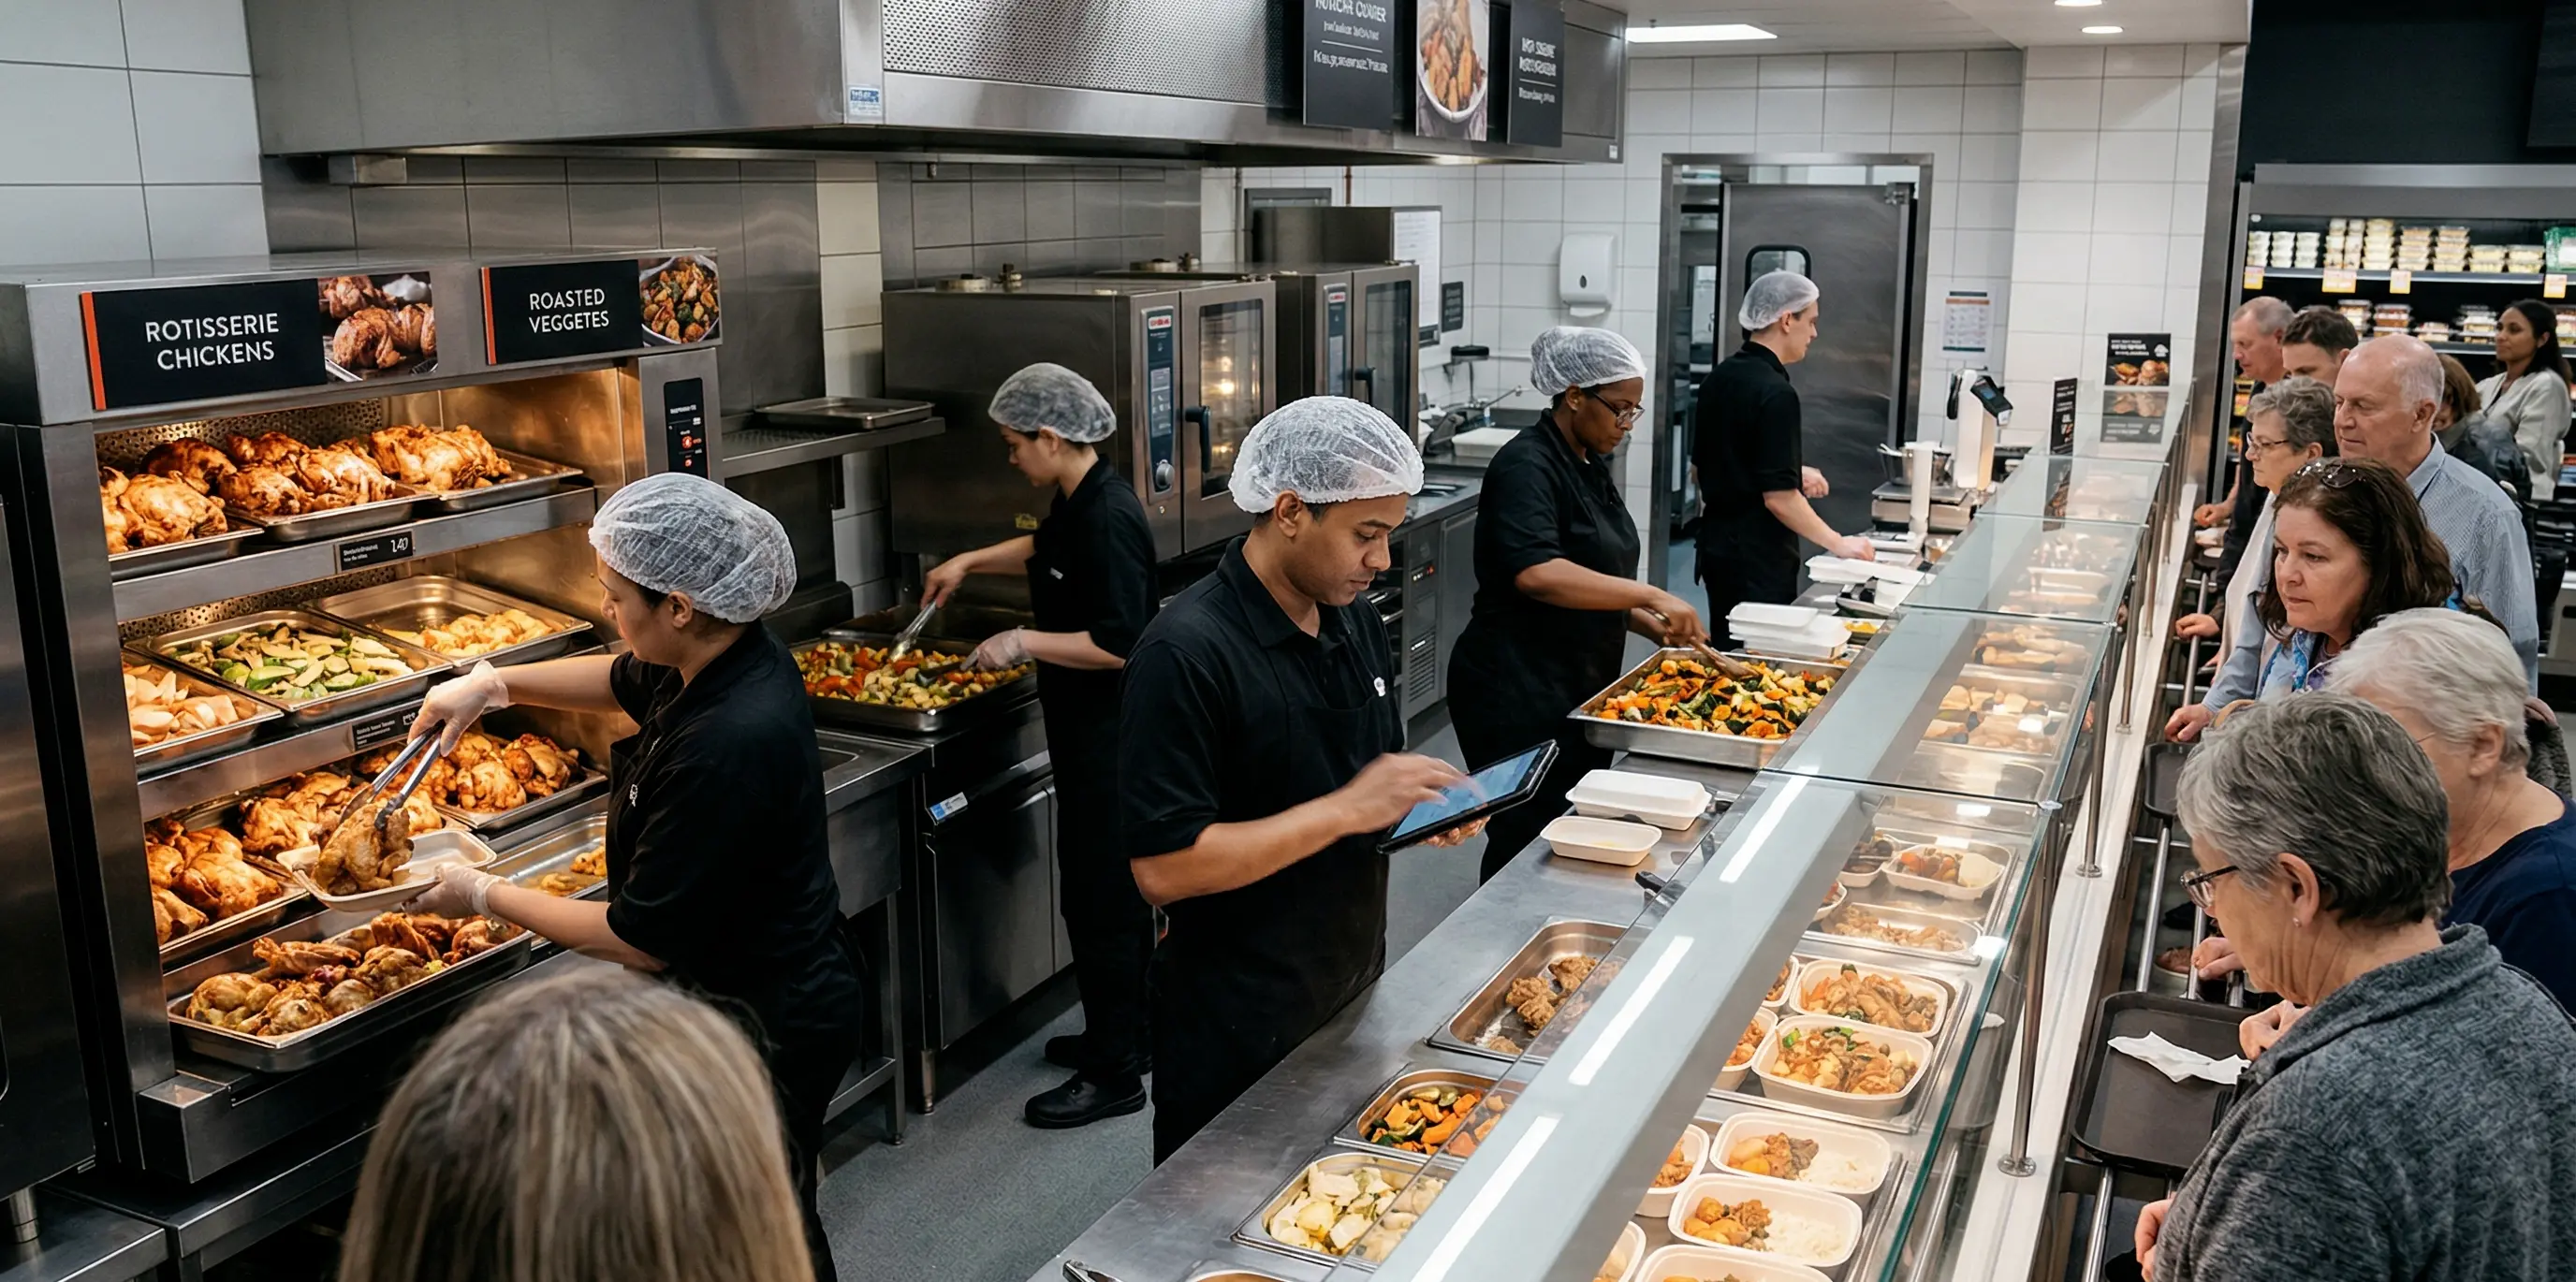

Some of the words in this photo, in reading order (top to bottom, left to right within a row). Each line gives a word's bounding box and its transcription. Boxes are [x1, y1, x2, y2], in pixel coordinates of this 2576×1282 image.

[529, 288, 605, 311] ROASTED
[145, 313, 279, 342] ROTISSERIE
[529, 310, 609, 333] VEGGETES
[157, 341, 275, 371] CHICKENS
